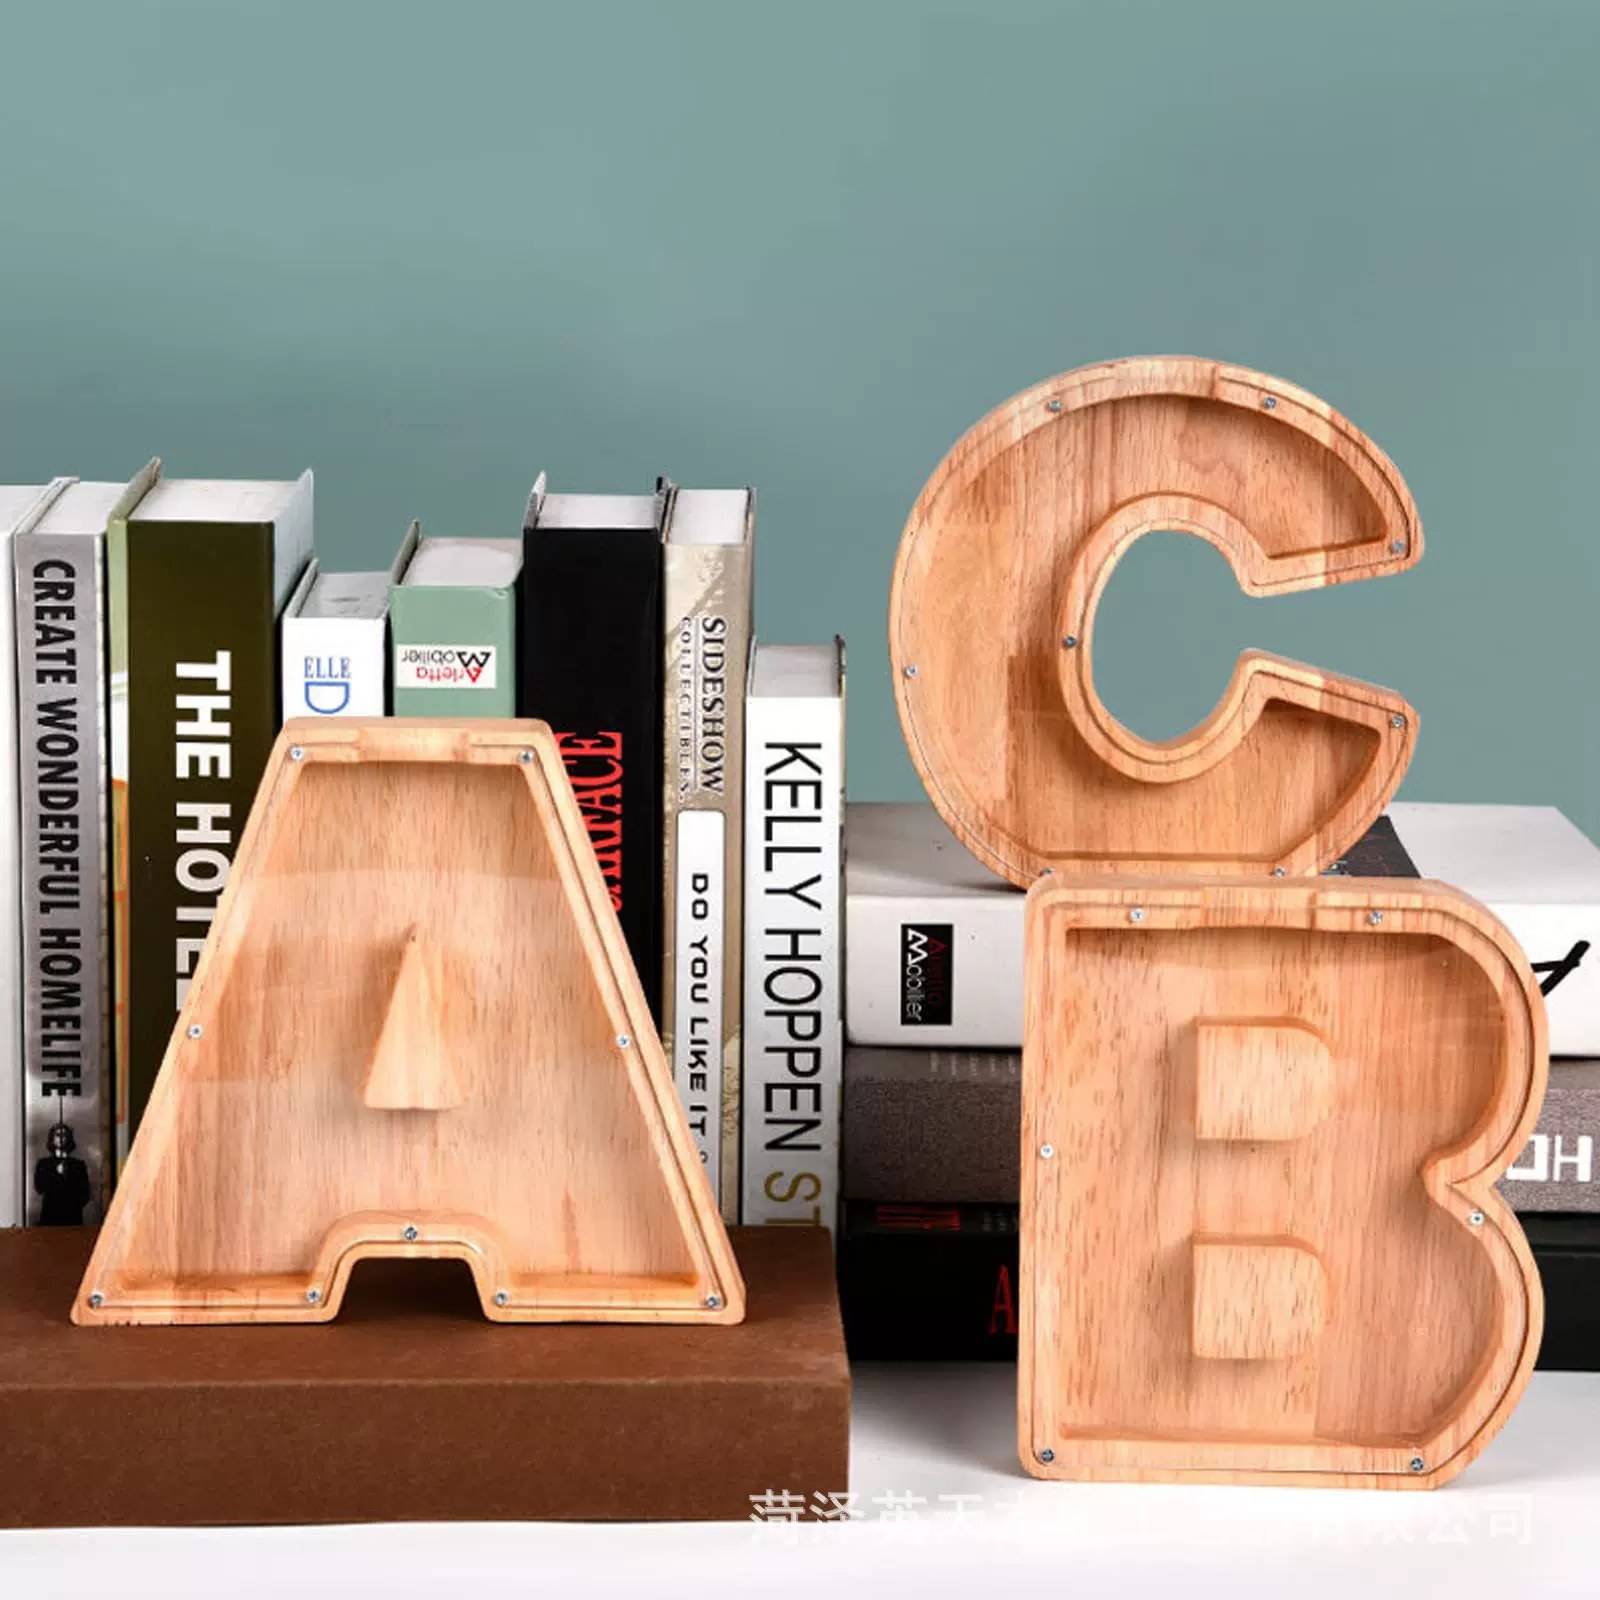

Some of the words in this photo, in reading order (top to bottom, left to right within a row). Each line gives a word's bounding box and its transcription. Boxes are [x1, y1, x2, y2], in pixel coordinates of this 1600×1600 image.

[33, 558, 77, 685] CREATE
[303, 656, 351, 679] ELLE
[175, 650, 232, 779] THE
[304, 681, 350, 714] D
[701, 616, 726, 795] SIDESHOW
[36, 697, 81, 915] WONDERFUL
[764, 742, 822, 910] KELLY
[691, 873, 709, 920] DO
[39, 928, 83, 1098] HOMELIFE
[689, 936, 709, 1004] YOU
[688, 1017, 709, 1092] LIKE
[764, 929, 823, 1152] HOPPEN
[689, 1105, 708, 1137] IT
